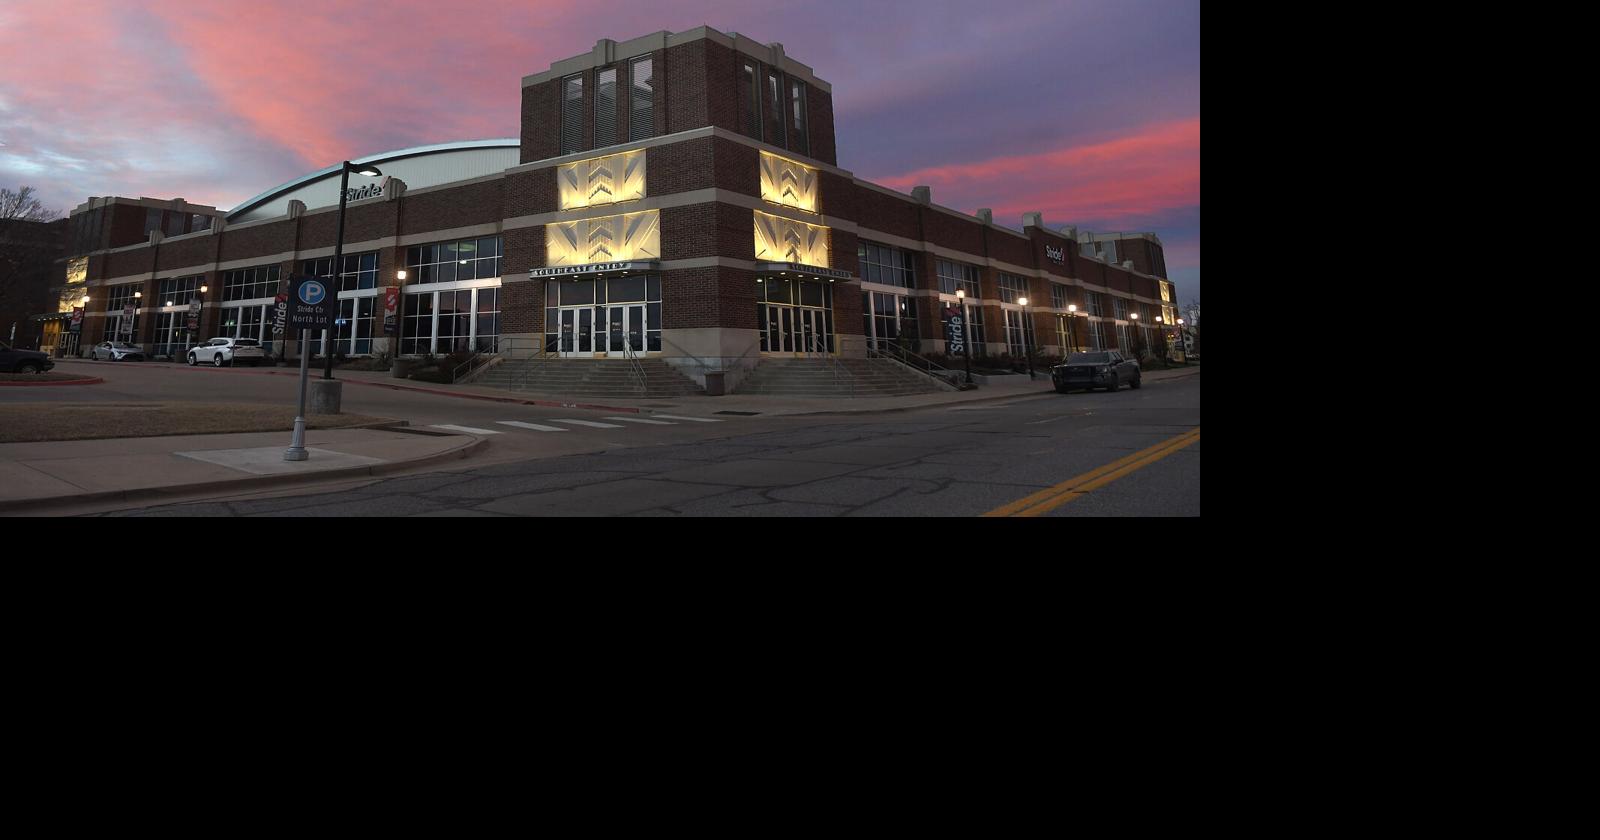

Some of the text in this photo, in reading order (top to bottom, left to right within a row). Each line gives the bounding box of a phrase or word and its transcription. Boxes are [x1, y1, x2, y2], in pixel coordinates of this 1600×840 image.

[346, 183, 383, 201] Stride
[533, 262, 625, 276] SOUTHEAST ENTRY
[305, 283, 322, 301] P
[297, 305, 324, 313] Stride Ctr
[272, 302, 287, 335] Stride
[292, 315, 328, 324] North Lot
[949, 316, 964, 352] Stride
